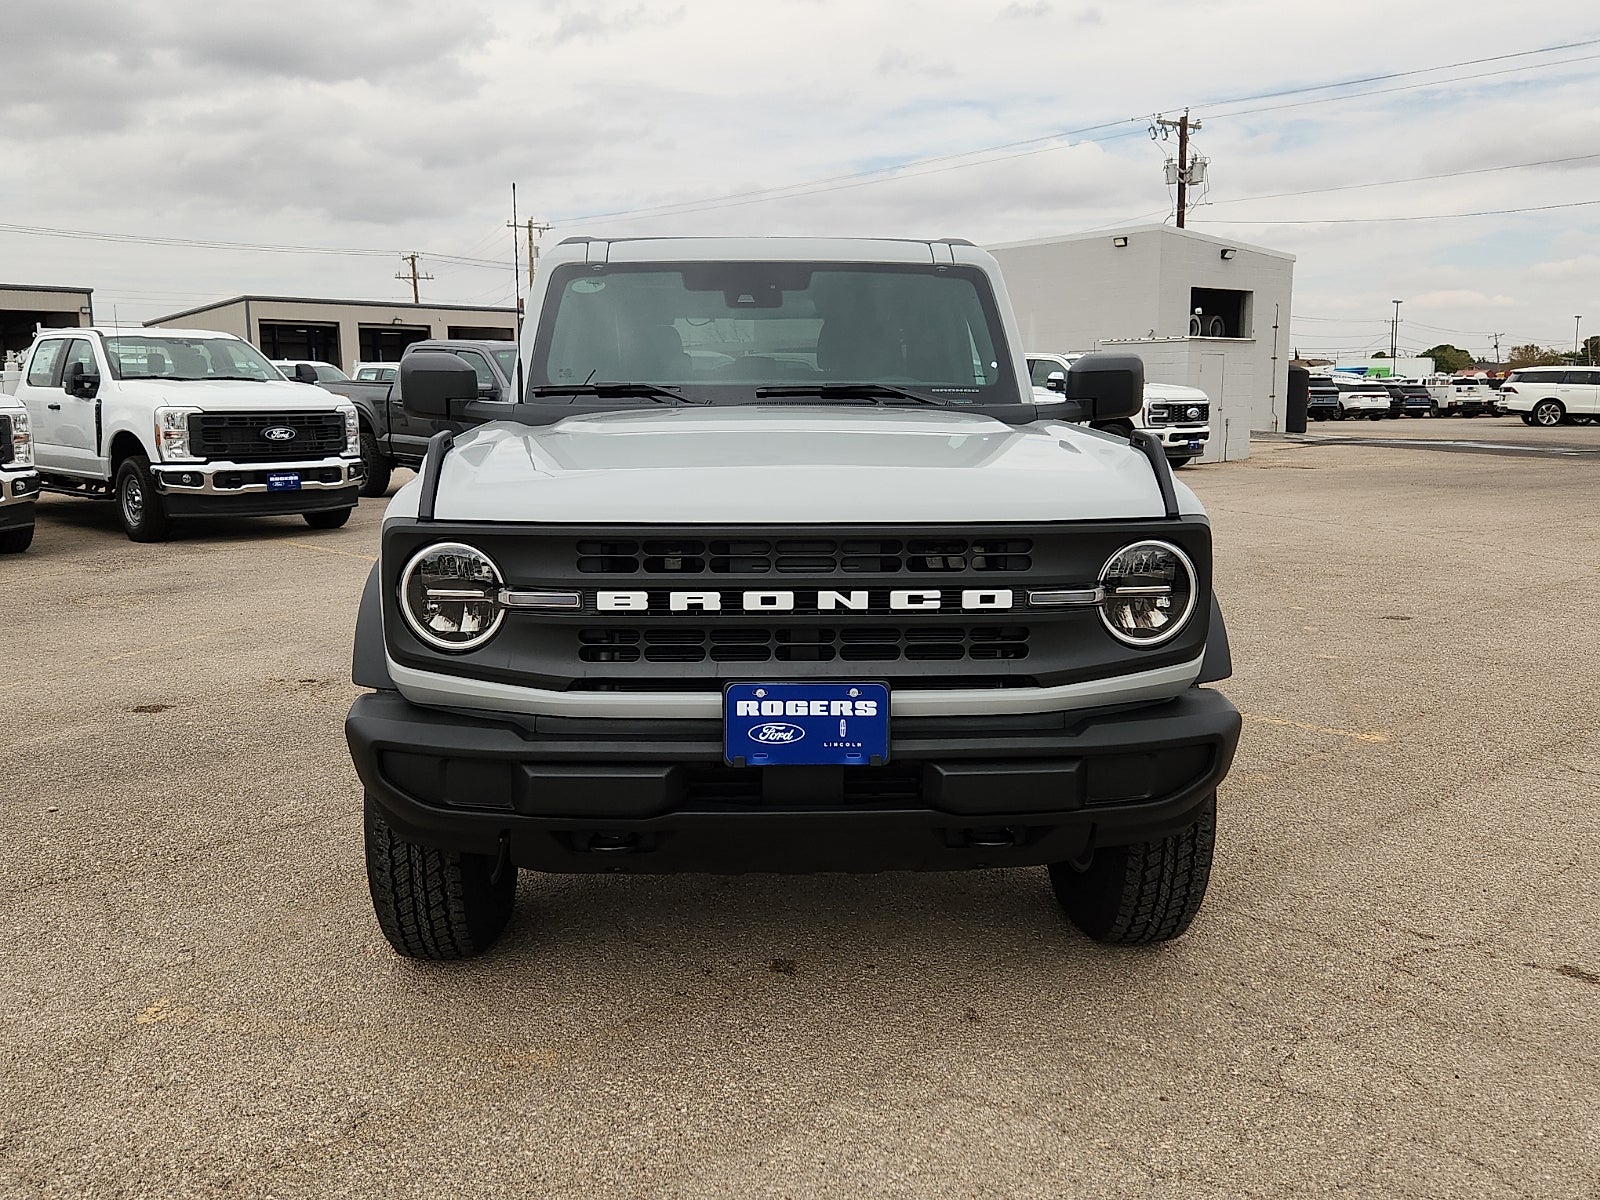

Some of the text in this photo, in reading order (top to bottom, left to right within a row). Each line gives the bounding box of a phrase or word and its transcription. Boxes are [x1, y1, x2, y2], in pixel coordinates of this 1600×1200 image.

[596, 590, 1013, 611] BRONCO
[736, 700, 878, 716] ROGERS
[758, 725, 794, 741] Ford
